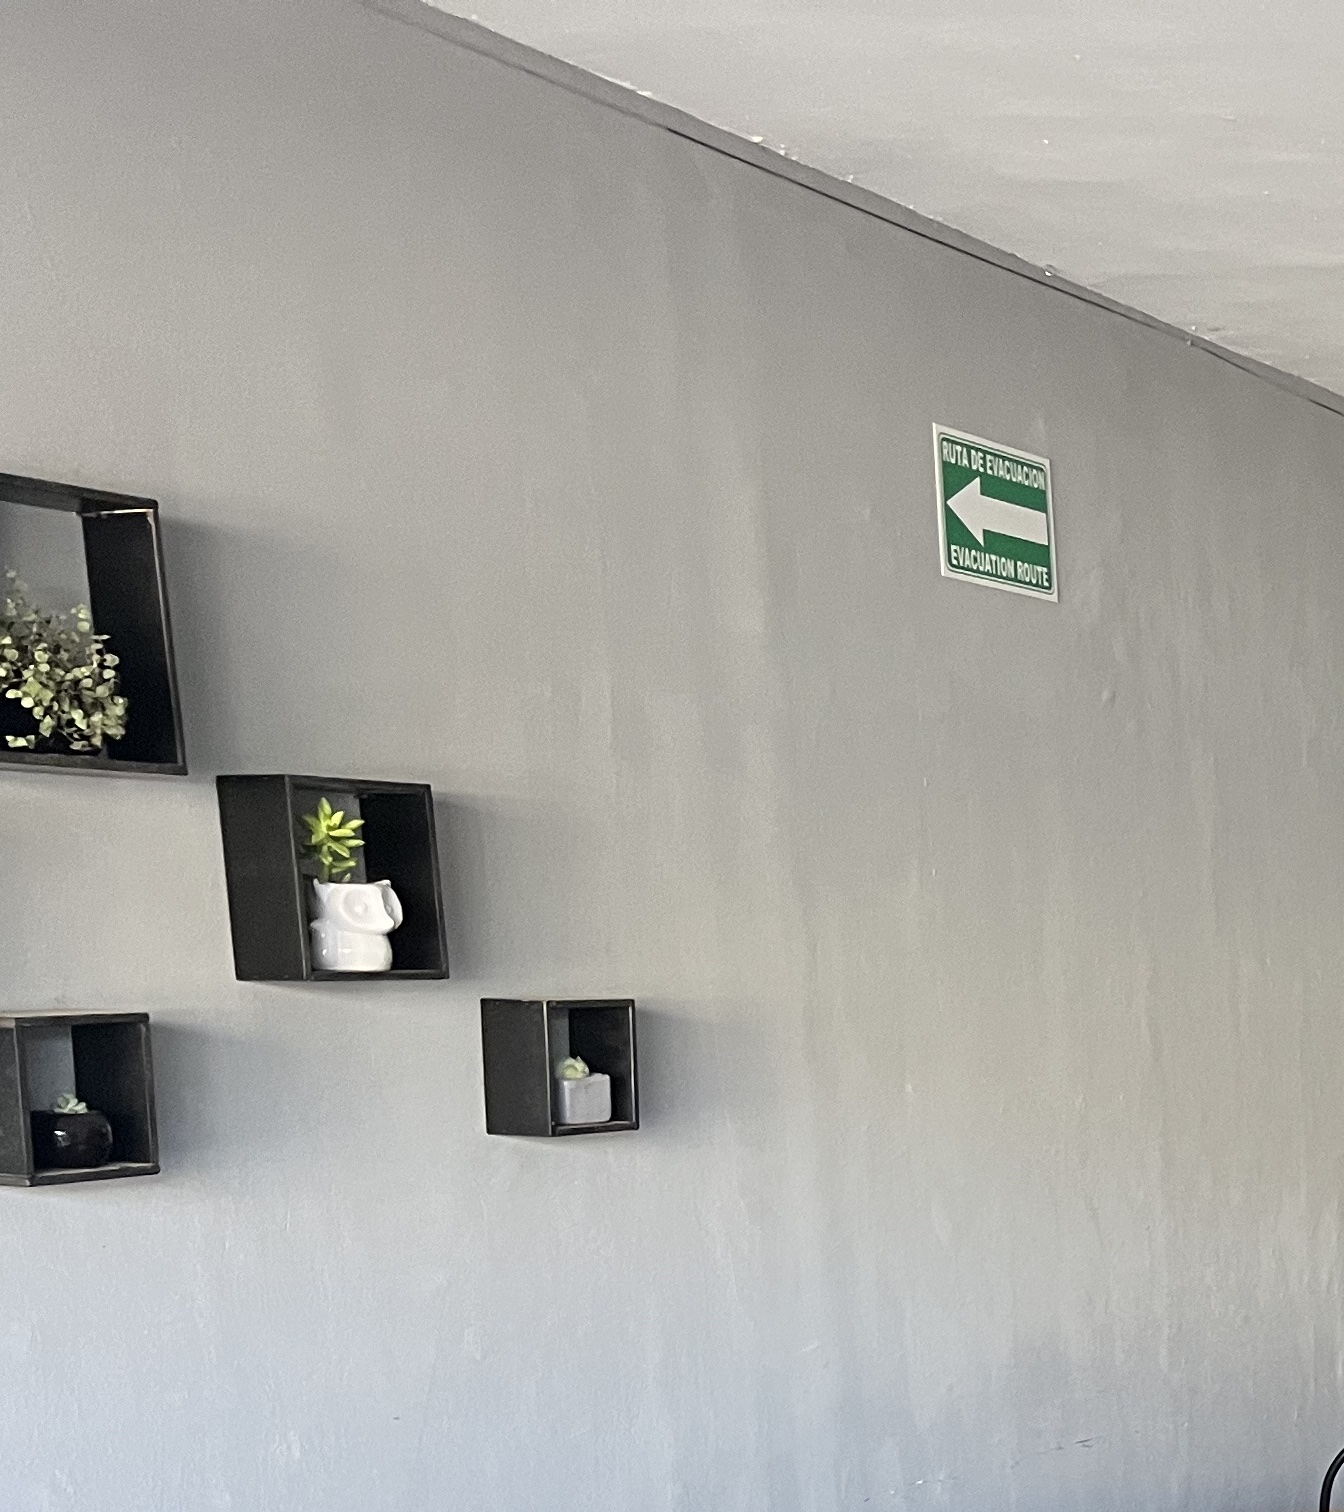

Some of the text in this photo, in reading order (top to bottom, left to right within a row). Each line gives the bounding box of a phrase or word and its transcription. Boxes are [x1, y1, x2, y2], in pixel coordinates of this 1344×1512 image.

[942, 440, 1046, 491] RUTA DE EVACUACION
[950, 544, 1050, 587] EVACUATION ROUTE
